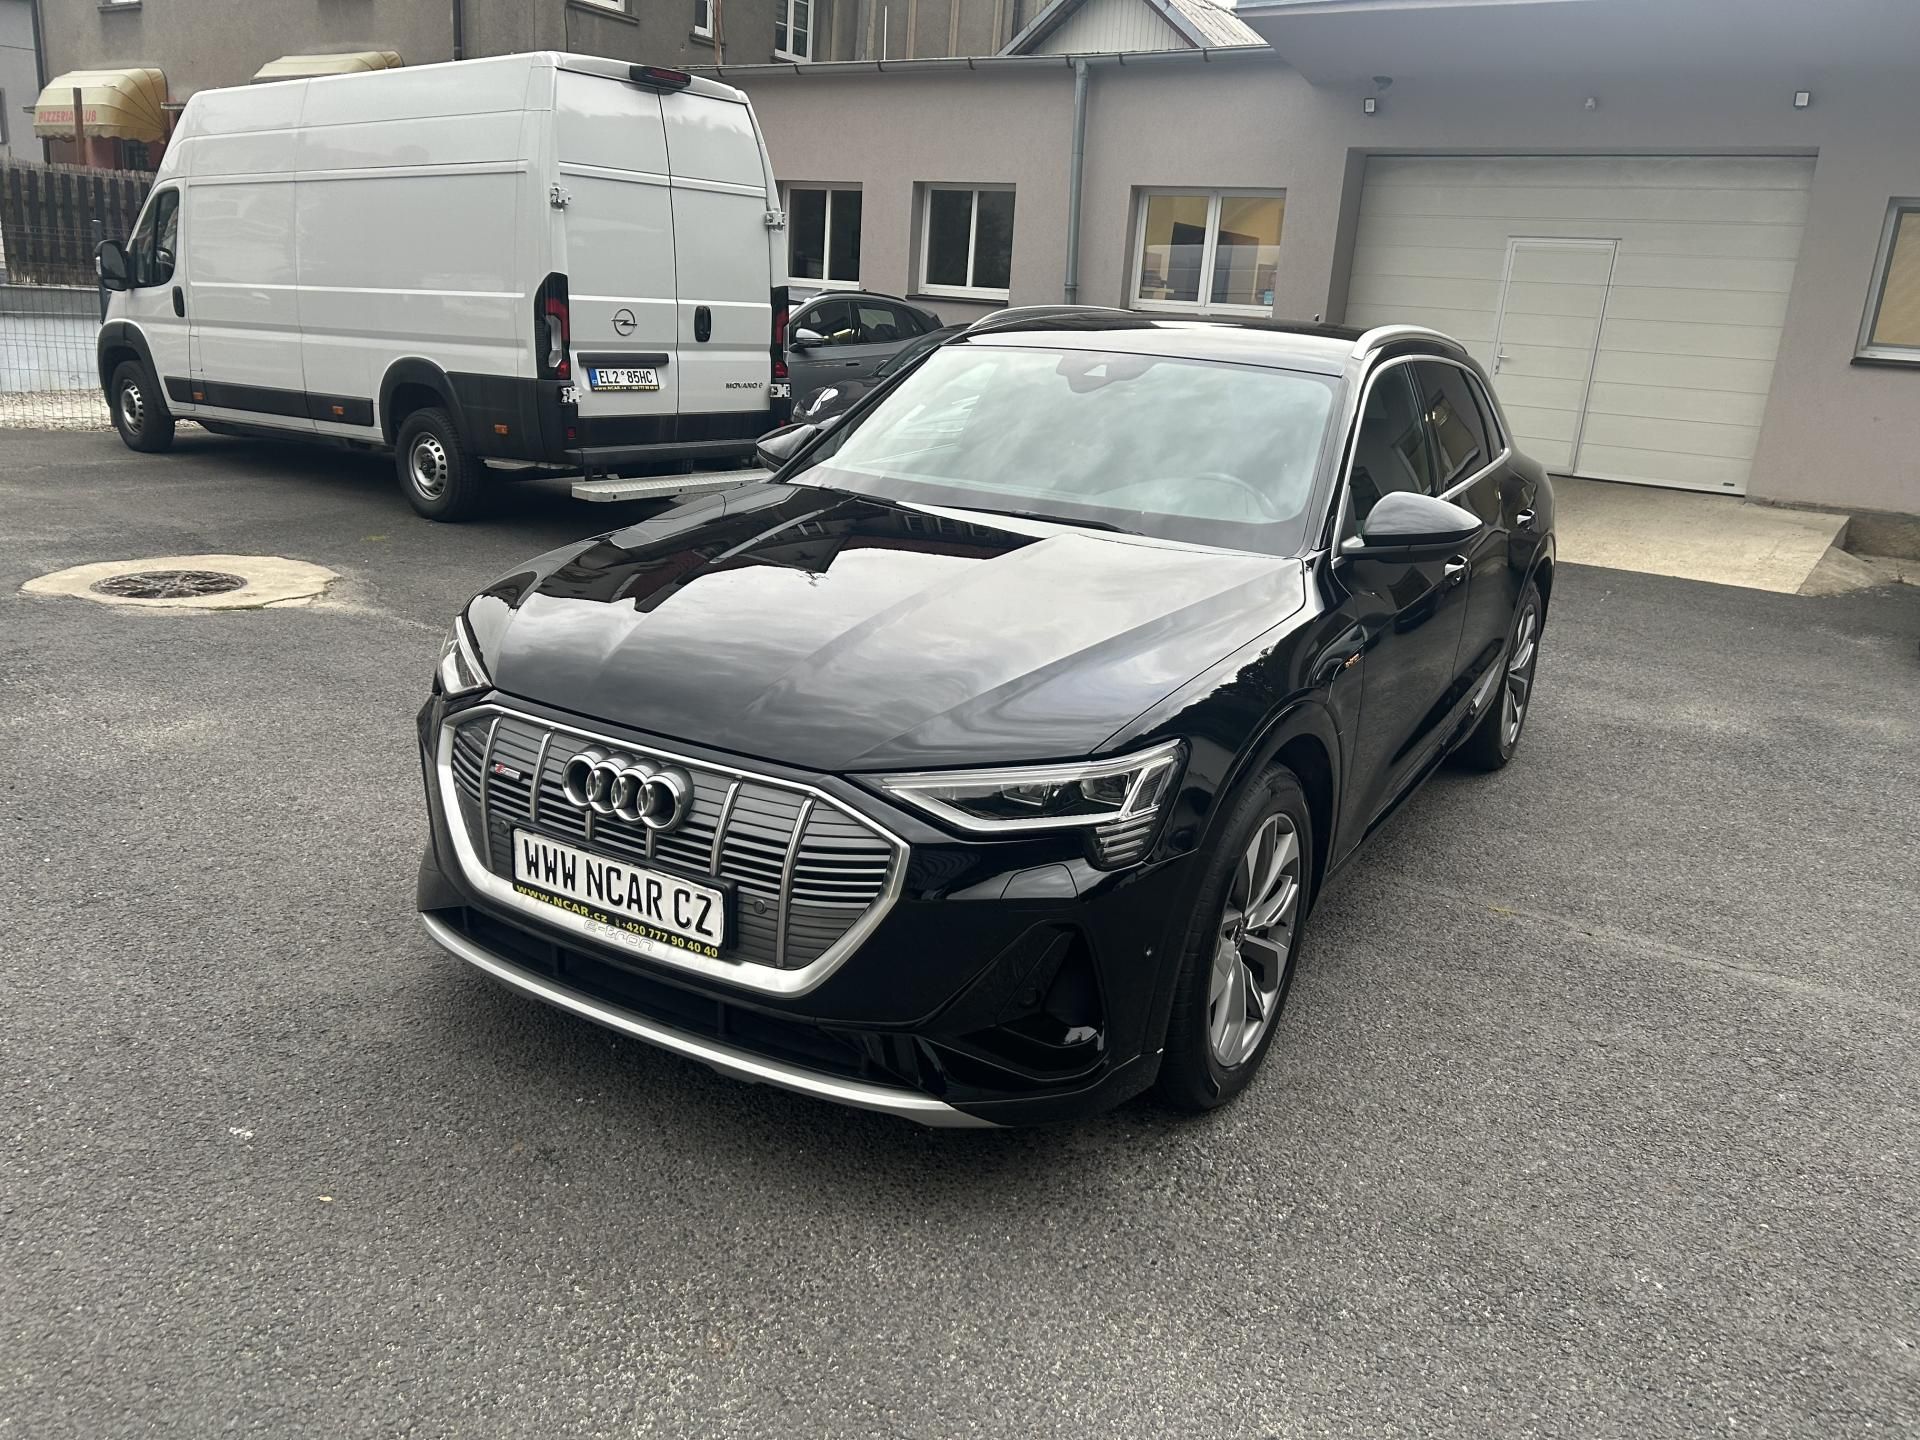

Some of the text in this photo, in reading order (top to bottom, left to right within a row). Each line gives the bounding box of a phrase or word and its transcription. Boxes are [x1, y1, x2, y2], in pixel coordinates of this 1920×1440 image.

[516, 884, 718, 958] www.NCAR.cz +420 777 90 40 40
[523, 838, 714, 937] WWW NCAR CZ
[584, 919, 654, 952] e-tron
